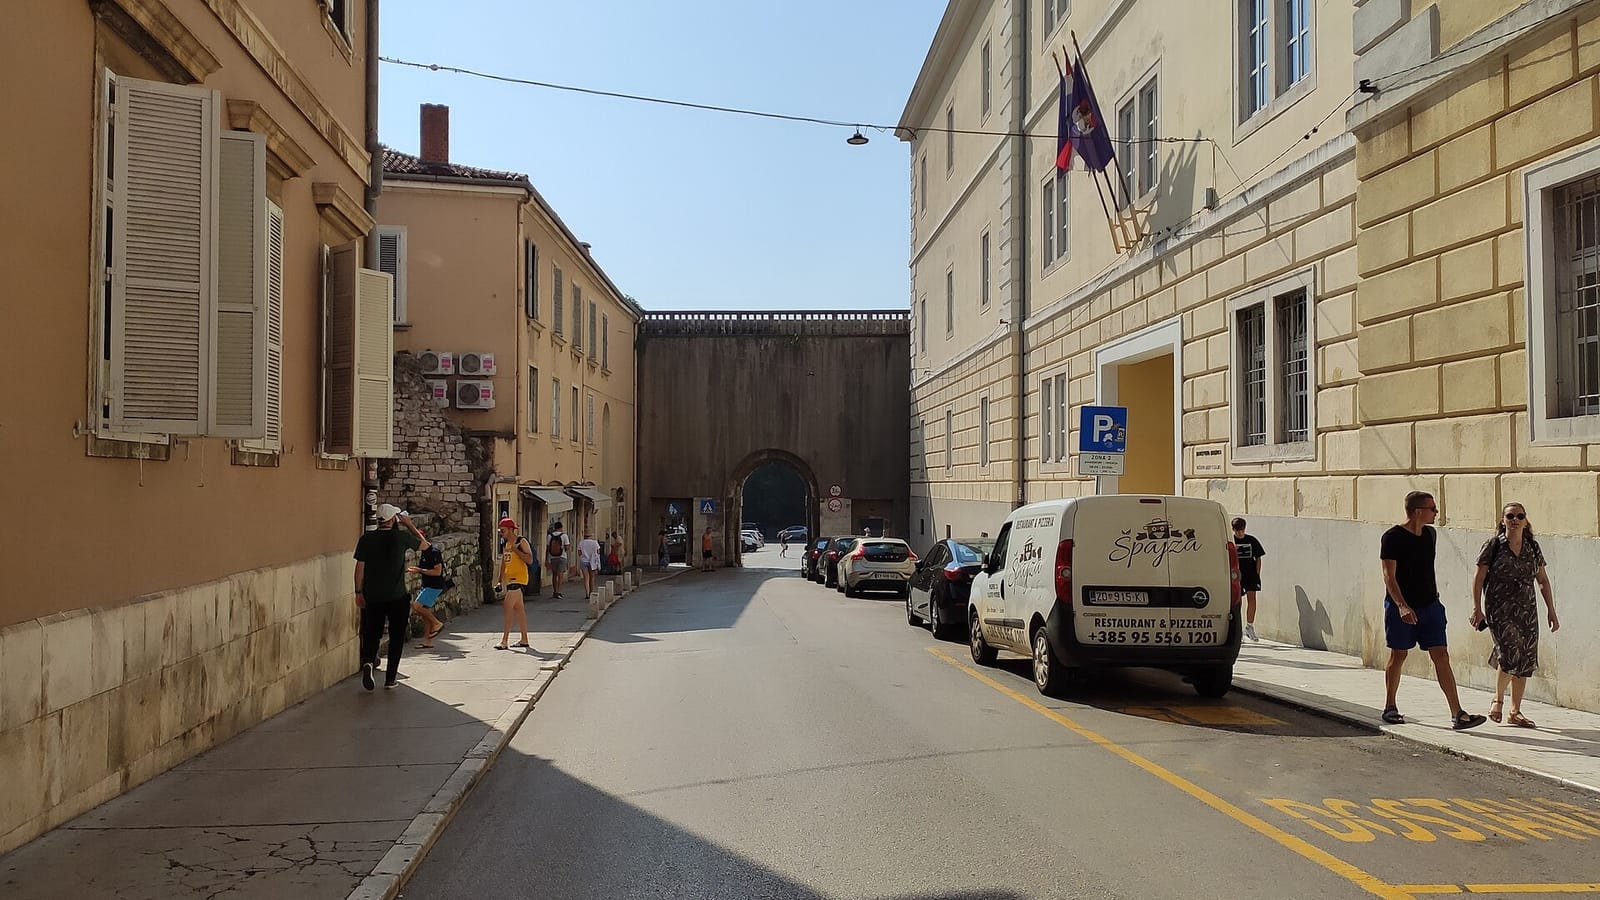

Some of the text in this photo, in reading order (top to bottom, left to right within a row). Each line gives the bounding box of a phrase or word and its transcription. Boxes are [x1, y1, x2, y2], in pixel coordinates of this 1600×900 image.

[1093, 414, 1113, 443] P
[1108, 529, 1202, 568] Špajza
[1095, 618, 1213, 629] RESTAURANT & PIZZERIA
[1088, 631, 1217, 644] +385 95 556 1201
